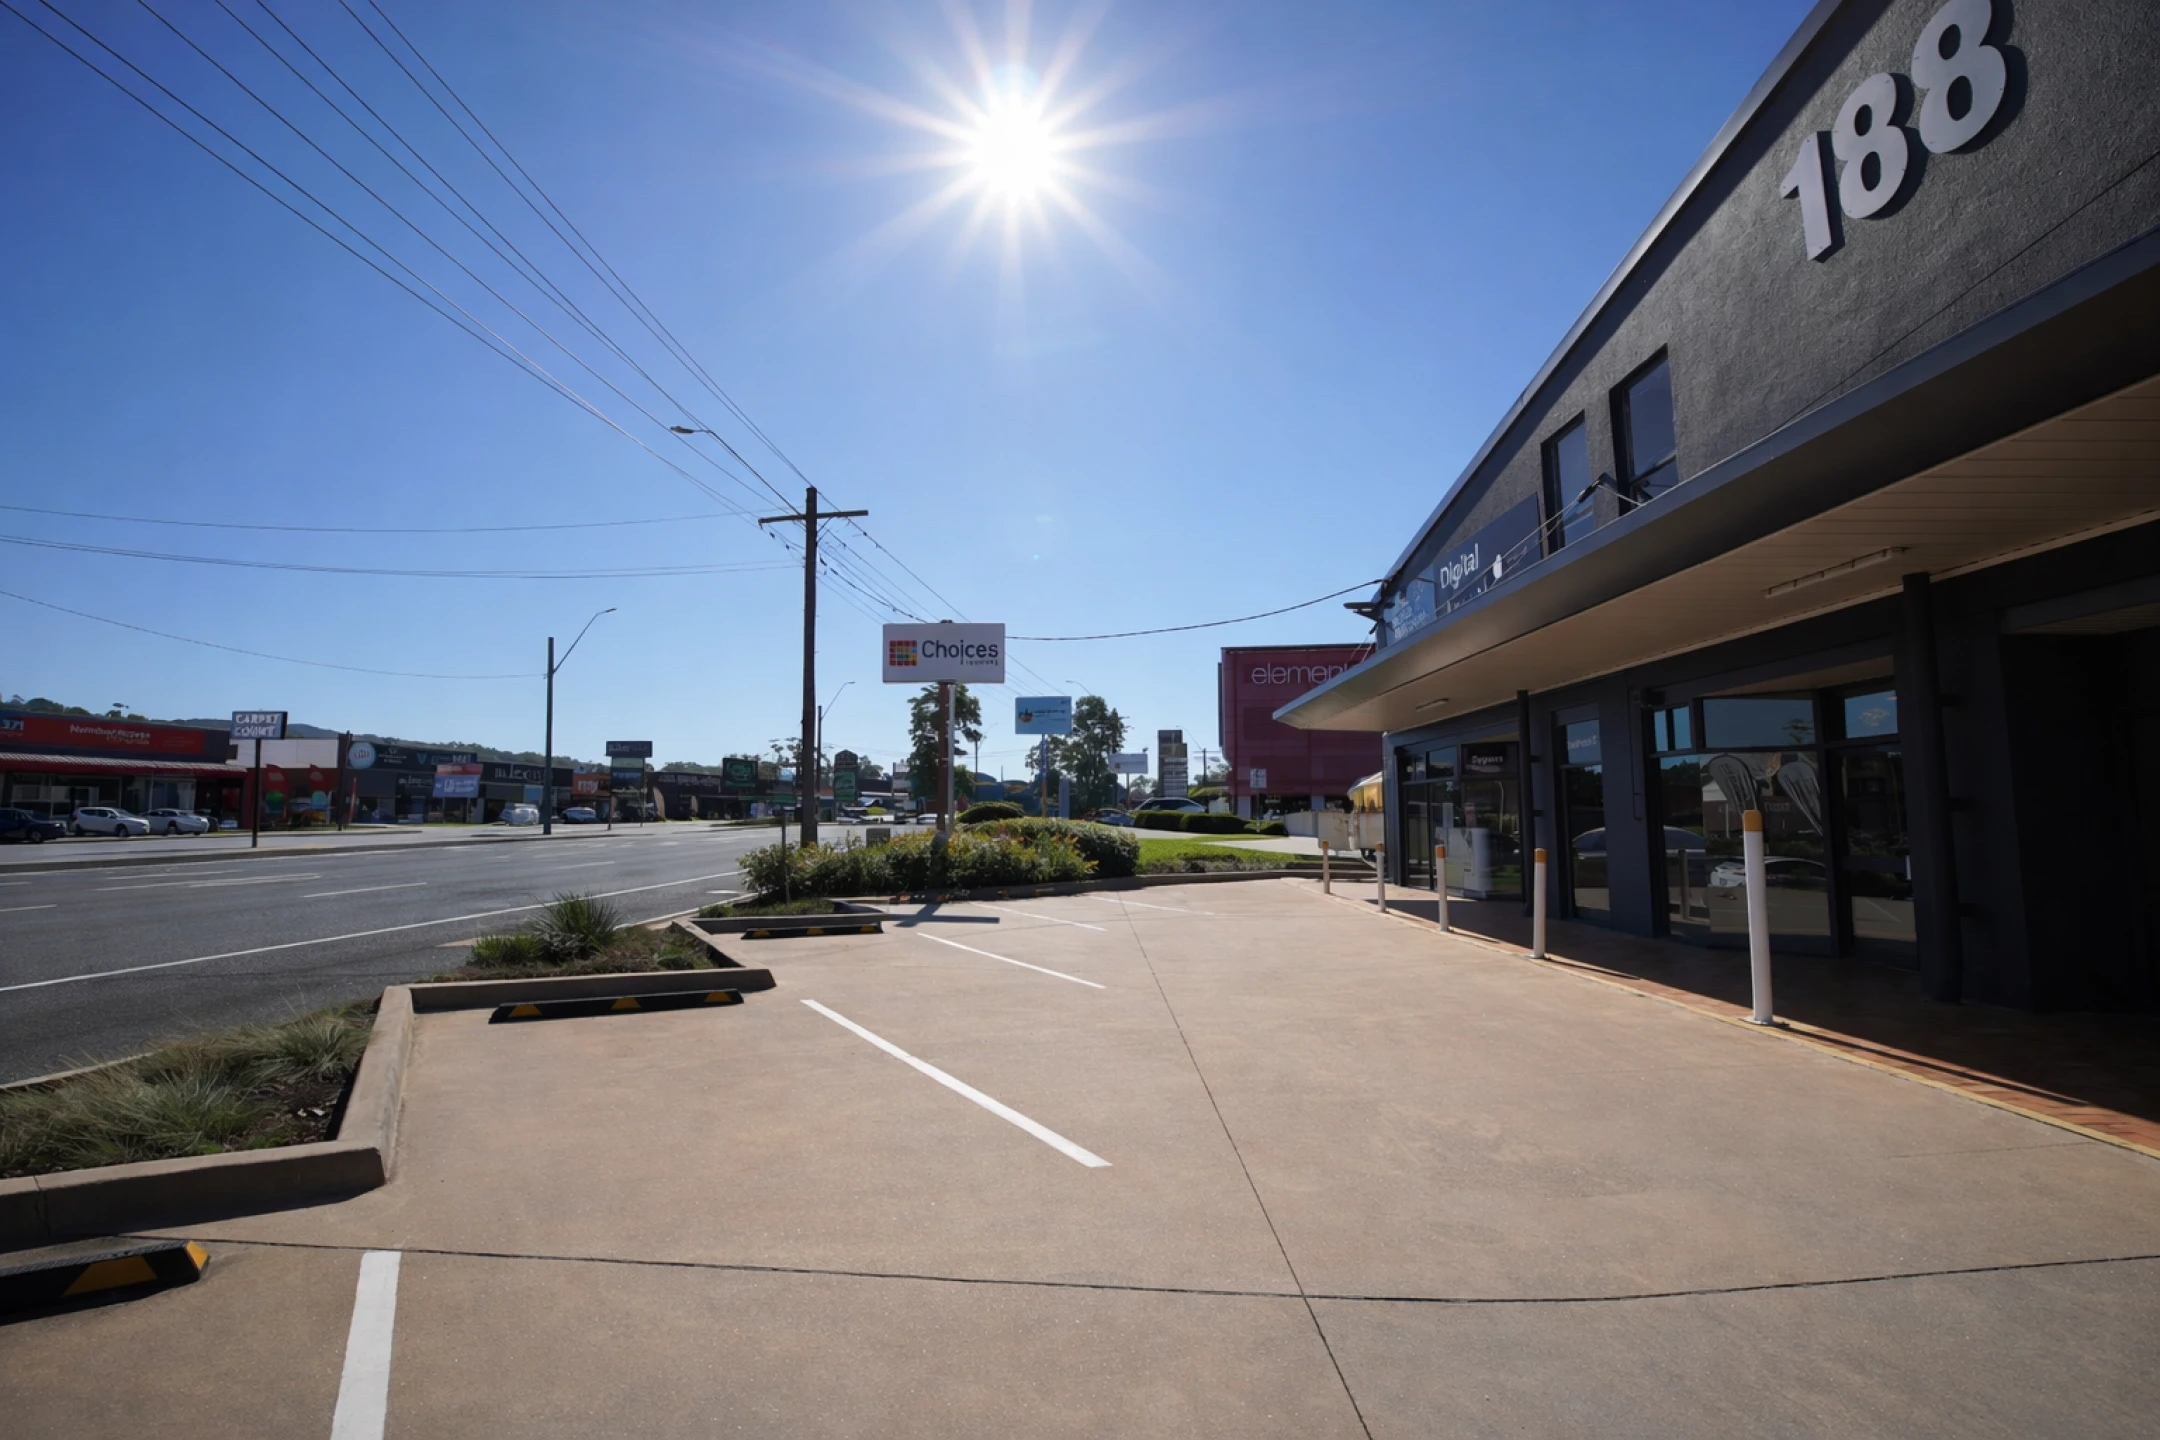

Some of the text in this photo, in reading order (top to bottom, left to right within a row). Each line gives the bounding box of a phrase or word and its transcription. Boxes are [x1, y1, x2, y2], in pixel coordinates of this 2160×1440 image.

[1779, 0, 2006, 260] 188
[1440, 542, 1479, 590] Digital
[921, 639, 999, 665] Choices
